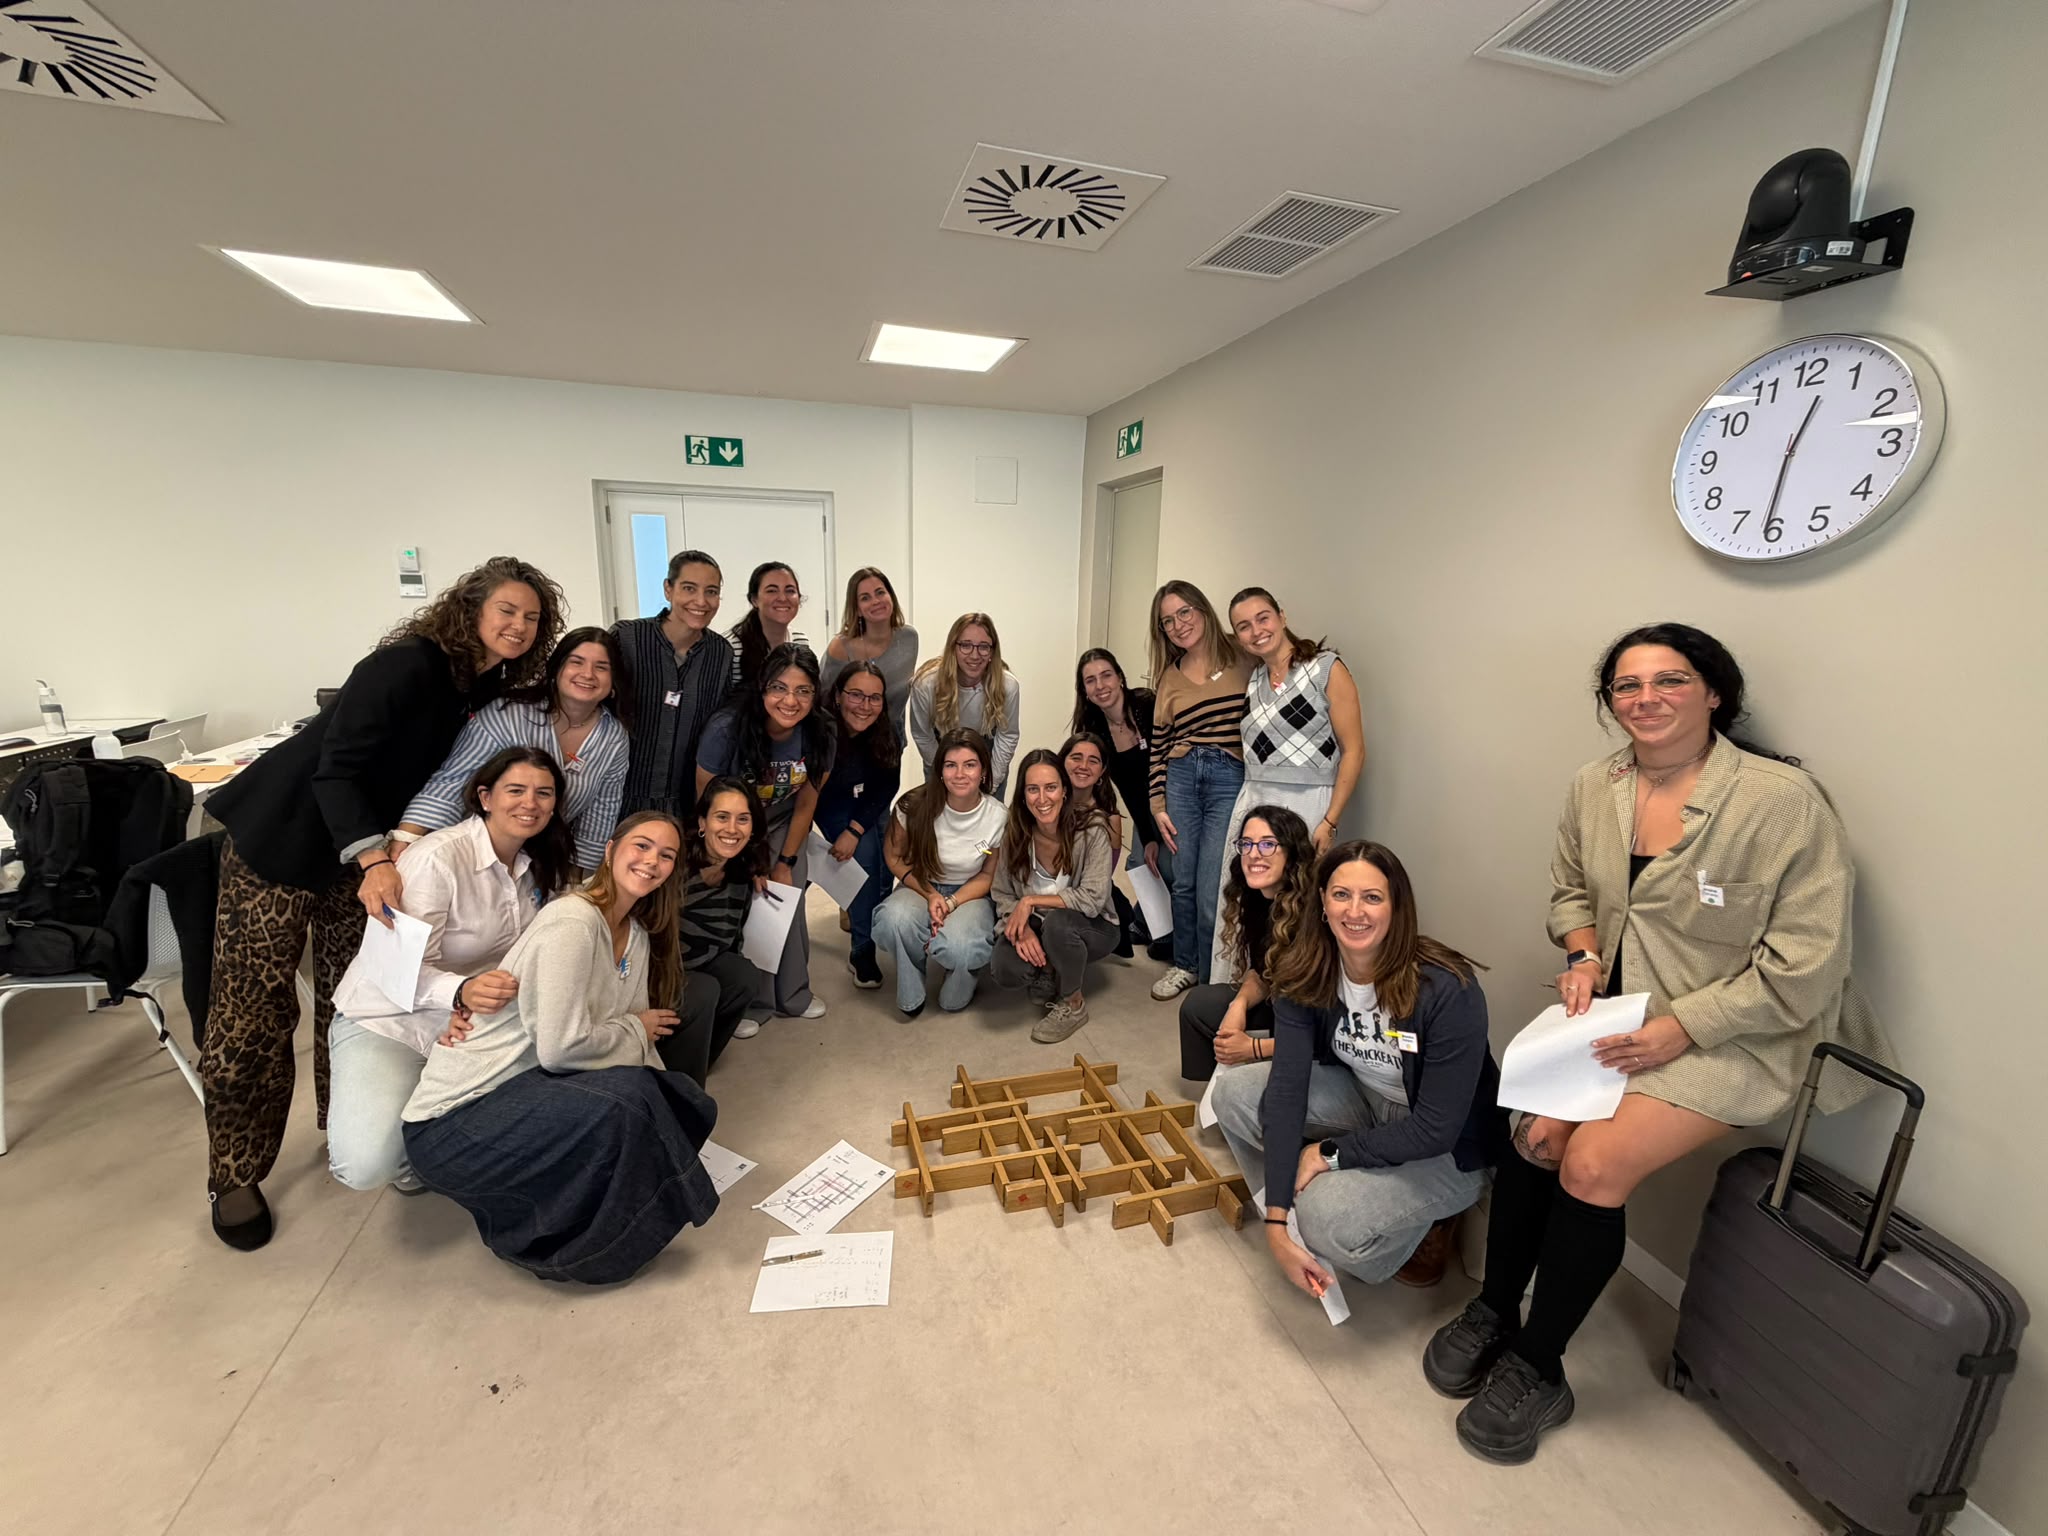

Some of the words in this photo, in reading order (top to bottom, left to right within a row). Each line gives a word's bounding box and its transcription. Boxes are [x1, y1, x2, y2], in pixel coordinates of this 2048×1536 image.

[1794, 357, 1829, 388] 12
[1848, 362, 1862, 390] 1
[1752, 377, 1780, 406] 11
[1870, 387, 1898, 418] 2
[1719, 411, 1750, 438] 10
[1877, 428, 1903, 457] 3
[1699, 451, 1718, 475] 9
[1704, 486, 1723, 510] 8
[1850, 474, 1873, 501] 4
[1732, 510, 1751, 534] 7
[1764, 518, 1785, 543] 6
[1807, 506, 1831, 532] 5
[1334, 1040, 1351, 1054] THE
